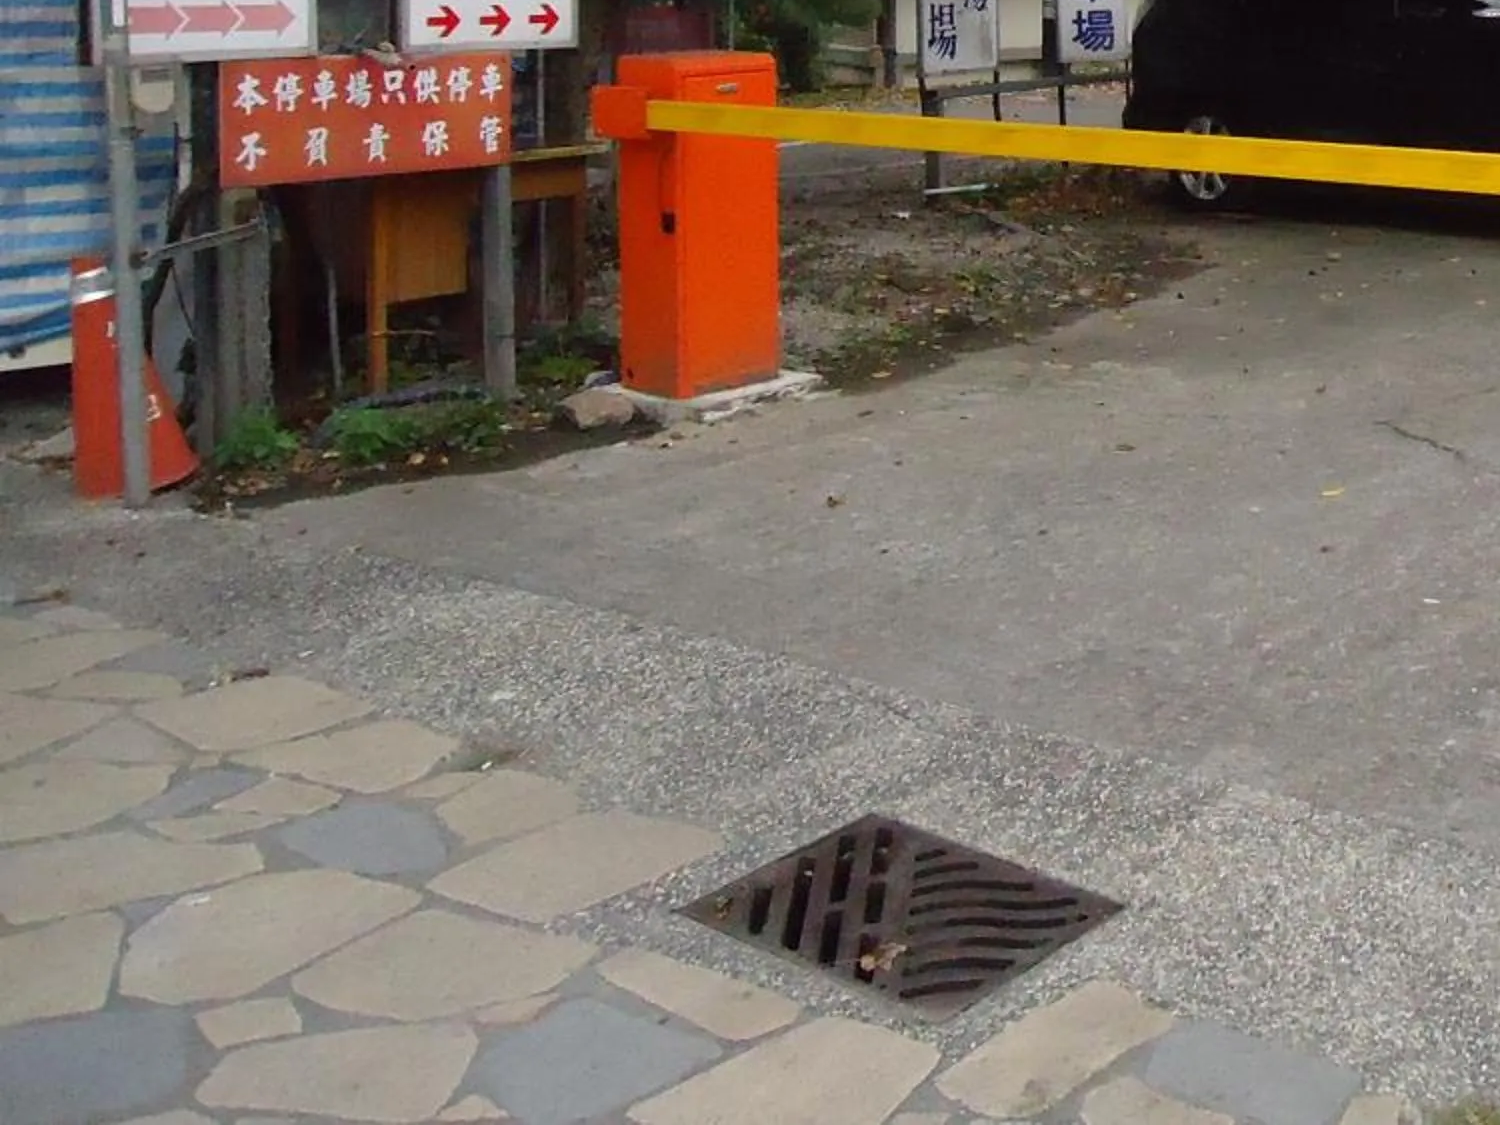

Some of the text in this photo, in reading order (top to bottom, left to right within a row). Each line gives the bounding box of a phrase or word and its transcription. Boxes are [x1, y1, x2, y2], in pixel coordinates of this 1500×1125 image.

[232, 61, 503, 116] 本停車場只供停車
